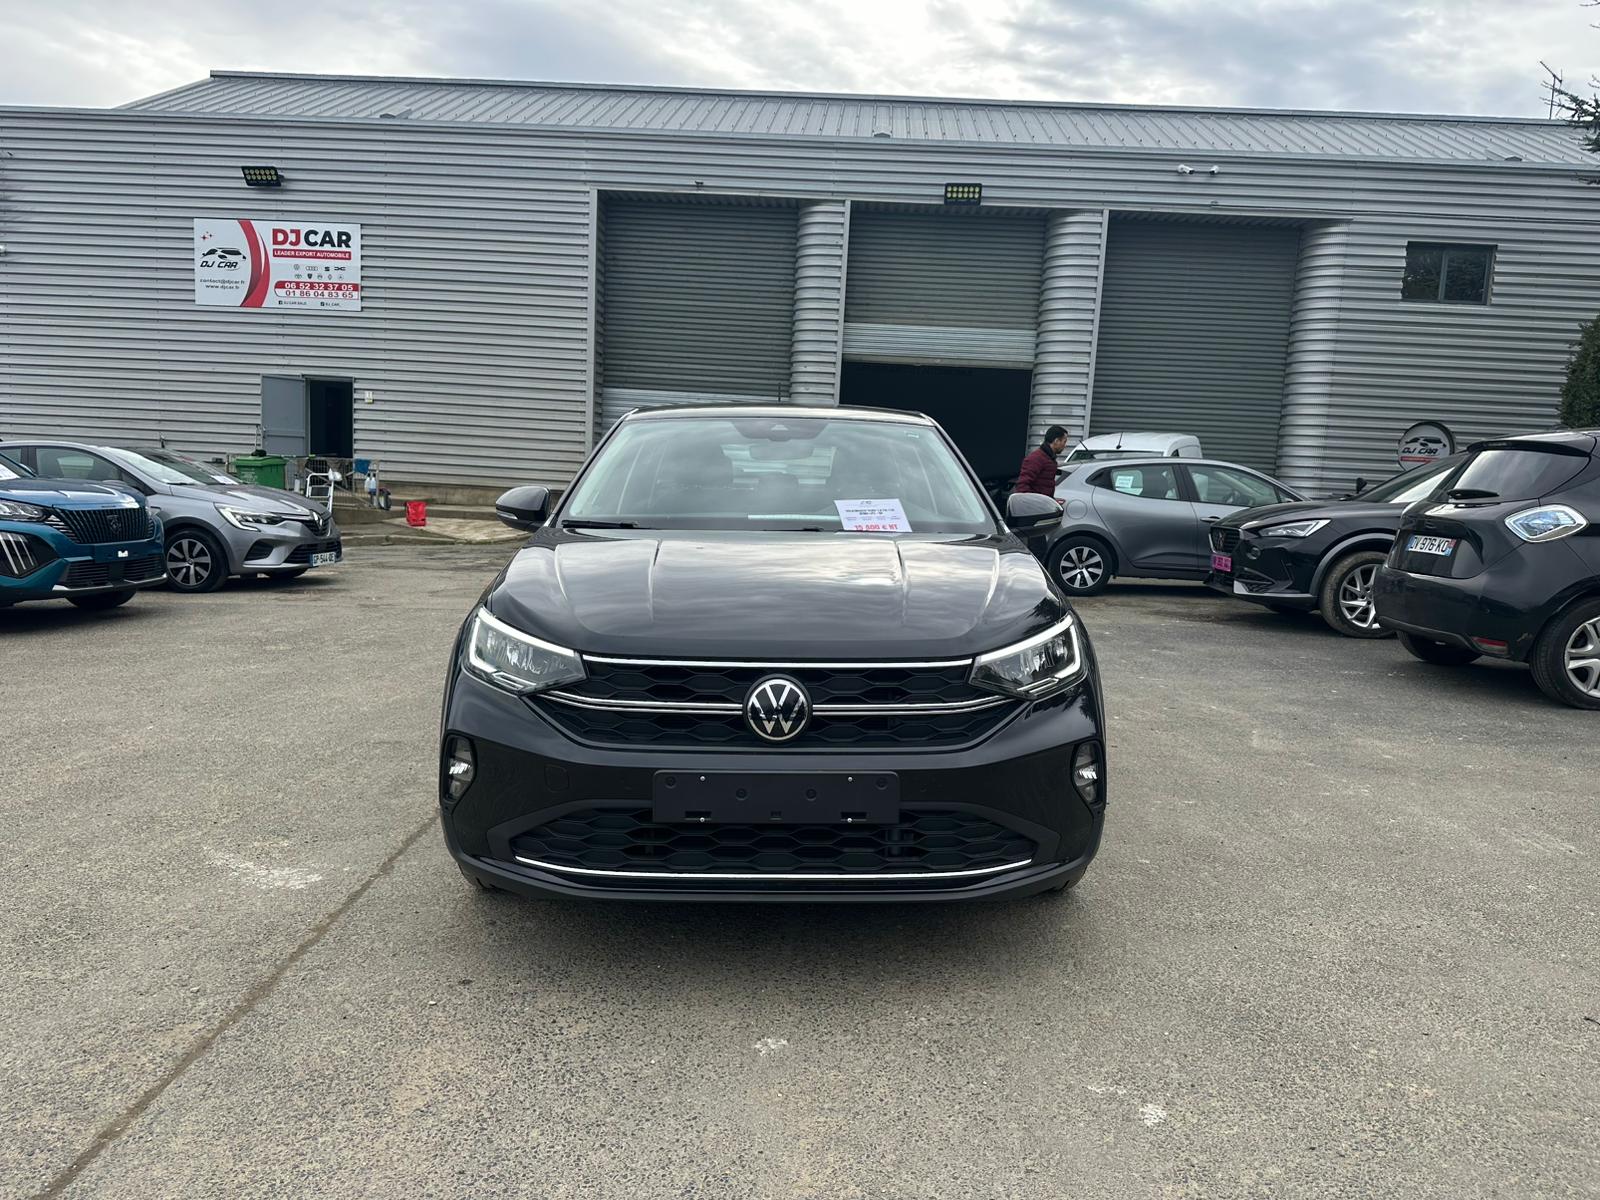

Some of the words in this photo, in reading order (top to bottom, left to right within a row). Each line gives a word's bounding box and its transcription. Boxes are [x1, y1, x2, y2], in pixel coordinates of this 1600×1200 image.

[272, 228, 301, 247] DJ
[303, 229, 352, 248] CAR
[200, 260, 215, 268] DJ
[327, 283, 339, 291] 37
[313, 290, 325, 298] 04
[341, 291, 354, 299] 65
[1417, 447, 1439, 455] CAR
